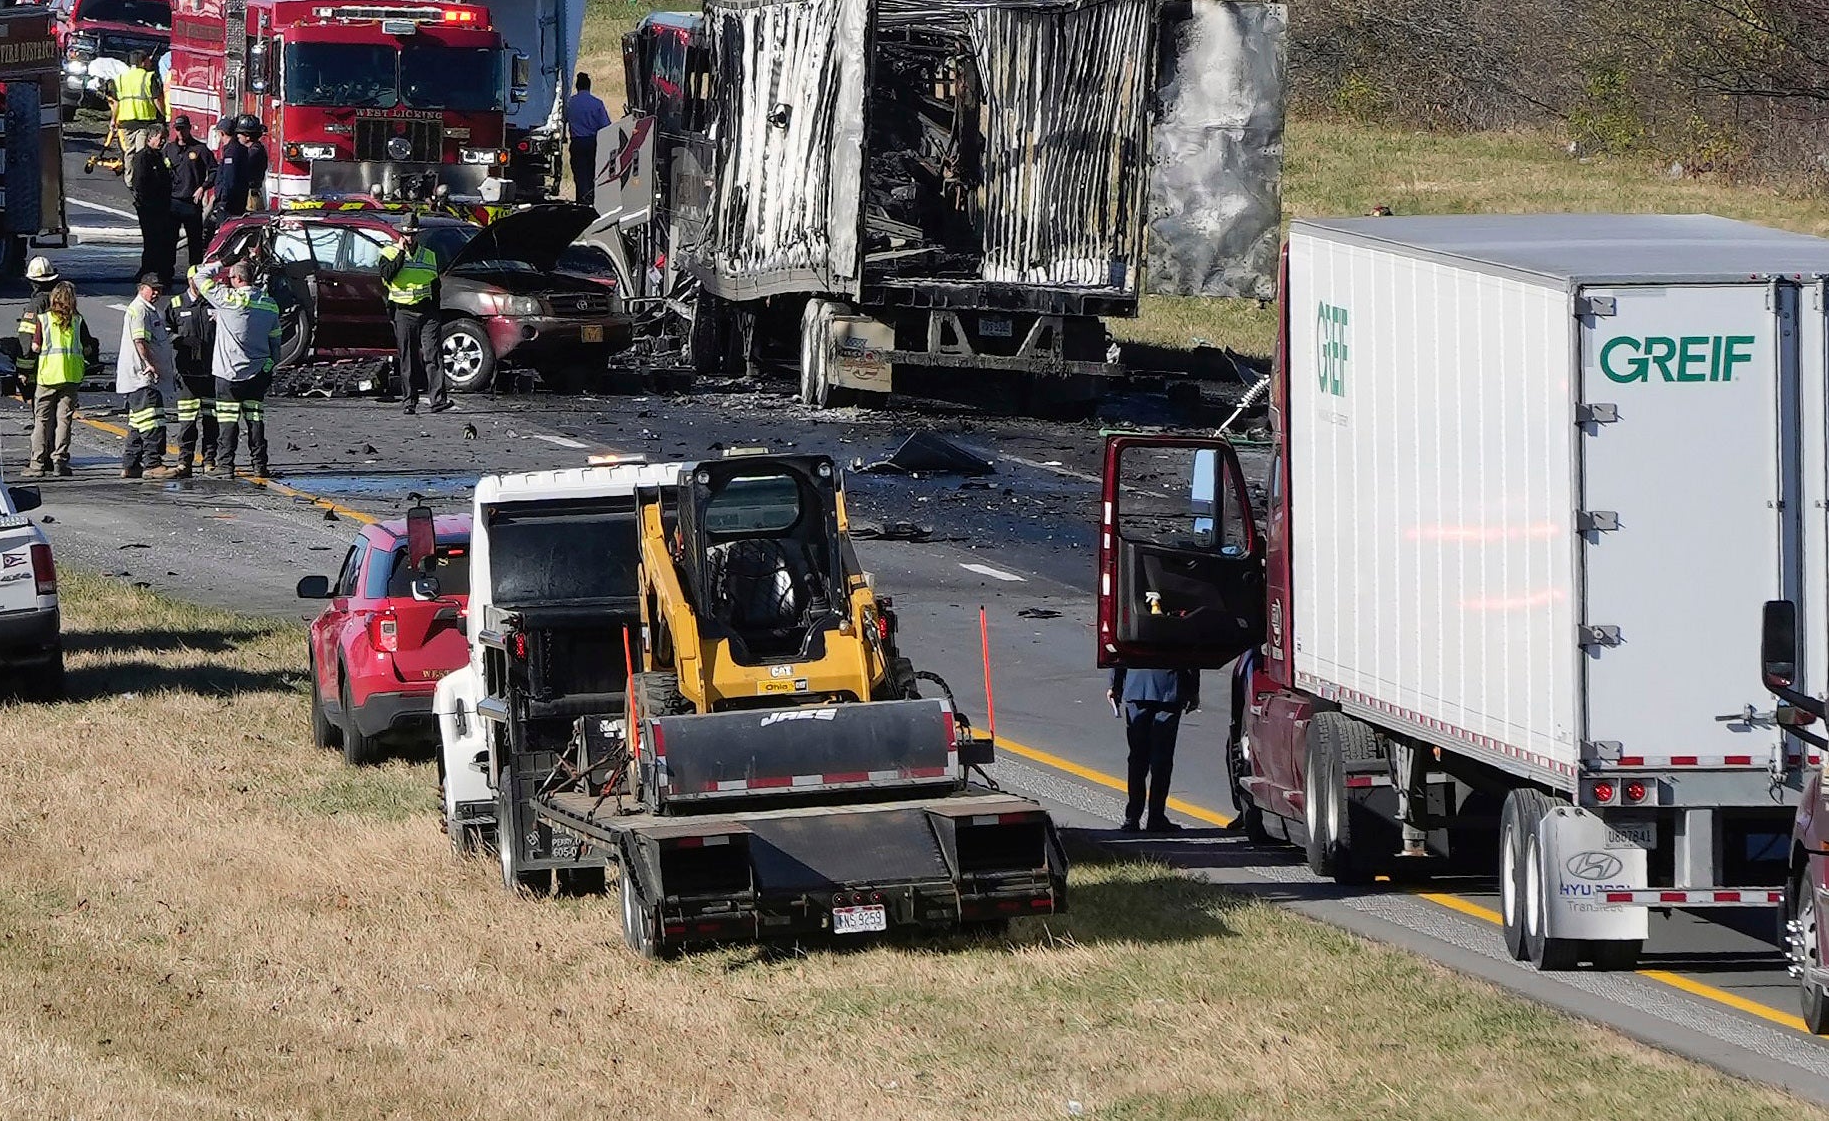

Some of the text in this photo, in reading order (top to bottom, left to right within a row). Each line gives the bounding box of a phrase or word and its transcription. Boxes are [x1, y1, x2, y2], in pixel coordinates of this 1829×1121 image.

[0, 43, 19, 63] FIRE
[20, 40, 56, 62] DISTRICT
[355, 108, 443, 119] WEST LICKING
[1317, 299, 1348, 398] GREIF
[1599, 335, 1756, 384] GREIF
[771, 665, 793, 677] CAT
[765, 683, 788, 691] Ohio
